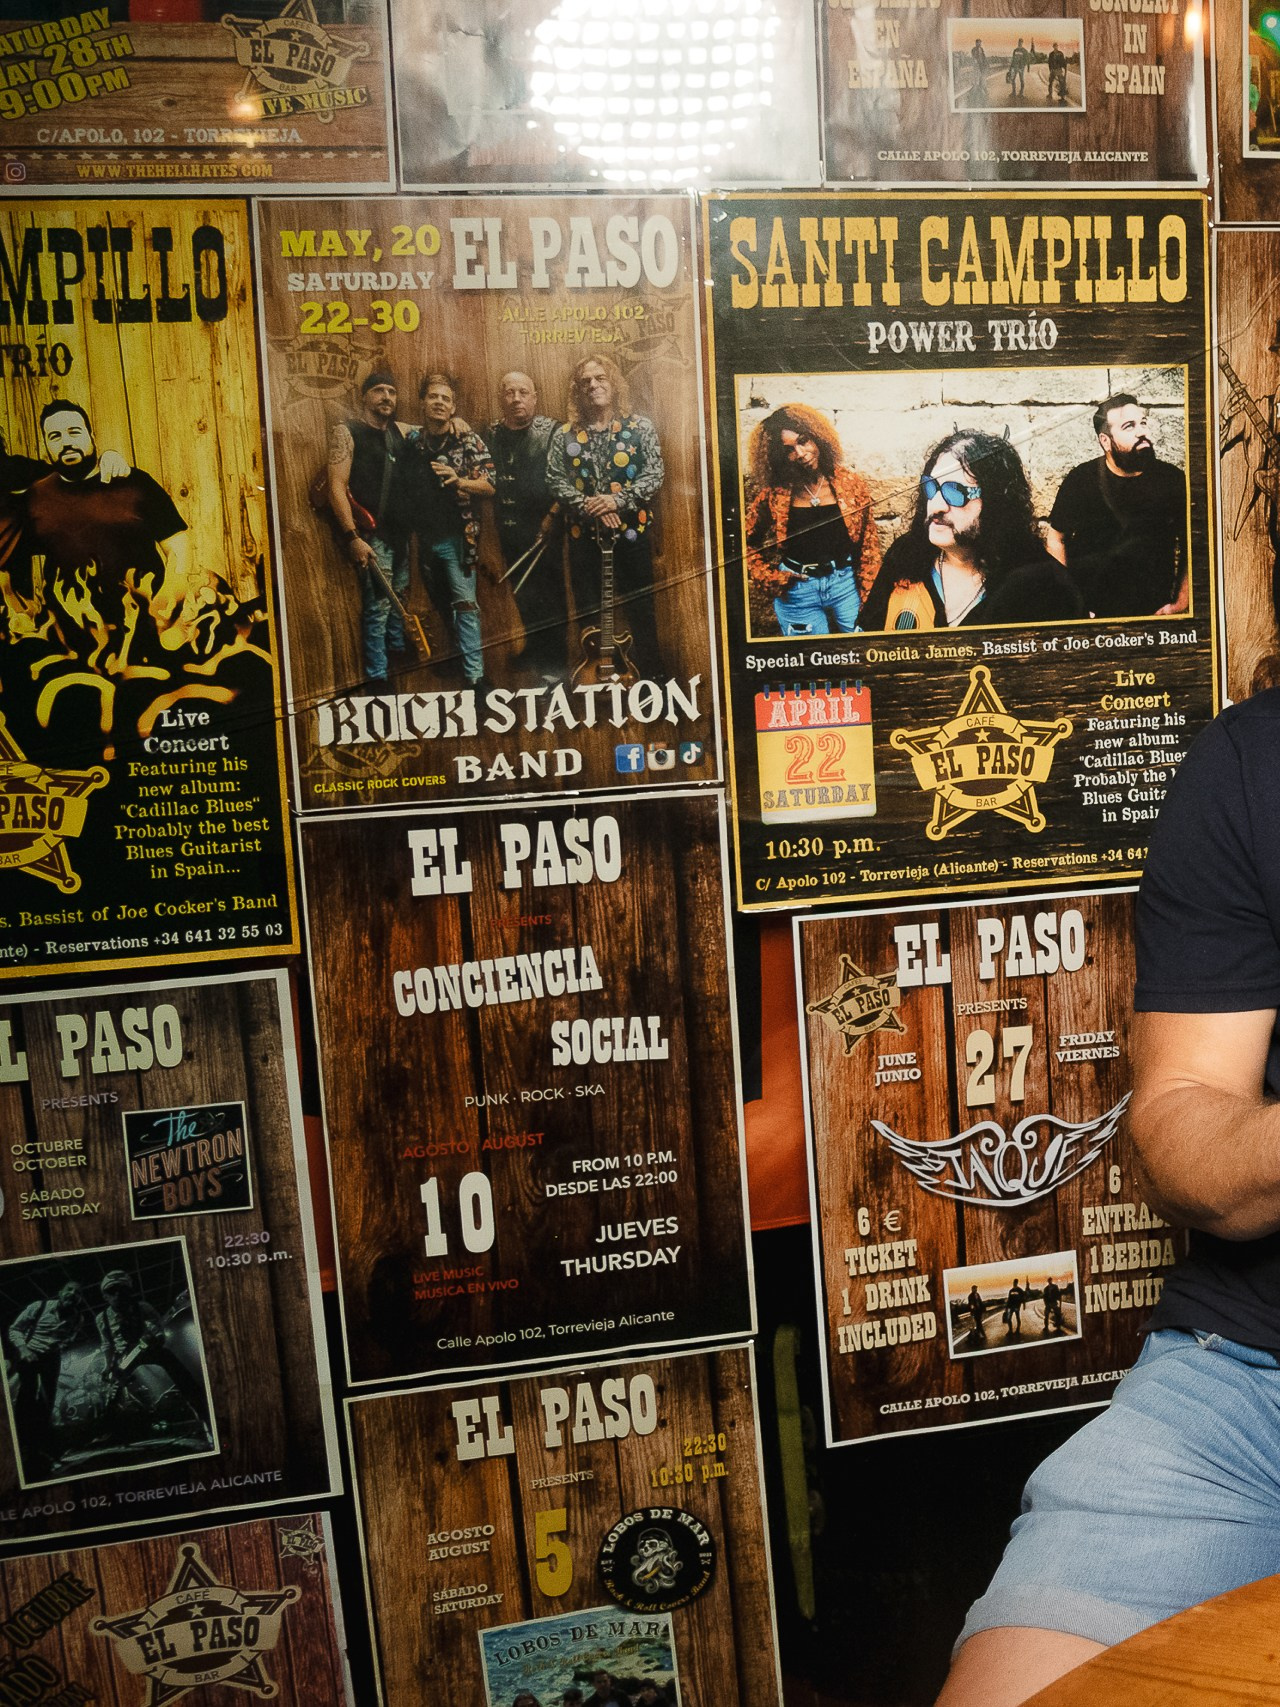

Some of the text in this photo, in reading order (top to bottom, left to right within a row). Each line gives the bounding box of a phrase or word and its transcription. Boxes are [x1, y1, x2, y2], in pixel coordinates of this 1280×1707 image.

[1123, 23, 1147, 53] IN
[43, 34, 134, 75] 28TH
[250, 39, 337, 77] EL PASO
[848, 55, 928, 89] ESPAÑA
[1105, 65, 1166, 95] SPAIN
[0, 68, 130, 119] 9:00PM
[296, 87, 368, 110] MUSIC
[37, 128, 128, 145] C/APOLO,
[134, 128, 165, 143] 102
[877, 151, 1149, 164] CALLE APOLO TORREVIEJA ALICANTE
[280, 224, 442, 263] MAY, 20
[450, 214, 679, 290] EL PASO
[729, 214, 1188, 309] SANTI CAMPILLO
[287, 271, 435, 291] SATURDAY
[300, 300, 421, 335] 22-30
[867, 319, 977, 354] POWER
[746, 629, 1198, 672] Special Guest: Oneida Bassist of Joe Band
[1114, 670, 1156, 687] Live
[318, 673, 703, 747] ROCK STATION
[767, 696, 861, 728] APRIL
[1100, 691, 1171, 711] Concert
[160, 709, 211, 728] Live
[1087, 712, 1186, 732] Featuring his
[143, 734, 230, 754] Concert
[1094, 737, 1124, 750] new
[128, 757, 249, 777] Featuring his
[453, 748, 584, 784] BAND
[784, 731, 848, 785] 22
[930, 745, 1036, 782] EL PASO
[138, 784, 174, 797] new
[314, 775, 448, 795] CLASSIC ROCK COVERS
[1073, 769, 1138, 787] Probably
[1142, 770, 1167, 783] the
[763, 783, 872, 809] SATURDAY
[114, 817, 271, 840] Probably the best
[126, 838, 263, 860] Blues Guitarist
[408, 815, 622, 897] EL PASO
[765, 837, 825, 860] 10:30
[150, 865, 168, 879] in
[776, 851, 1098, 891] Apolo Torrevieja Reservations
[19, 907, 85, 928] Bassist
[92, 906, 109, 921] of
[116, 904, 149, 920] Joe
[231, 894, 278, 911] Band
[45, 937, 149, 956] Reservations
[185, 928, 212, 944] 641
[218, 927, 237, 941] 32
[242, 925, 261, 939] 55
[265, 922, 284, 937] 03
[893, 909, 1086, 988] EL PASO
[393, 945, 604, 1017] CONCIENCIA
[855, 988, 891, 1014] PASO
[957, 998, 1028, 1016] PRESENTS
[56, 1003, 184, 1078] PASO
[551, 1016, 669, 1066] SOCIAL
[1059, 1031, 1116, 1047] FRIDAY
[877, 1052, 917, 1070] JUNE
[965, 1025, 1034, 1107] 27
[1055, 1046, 1121, 1063] VIERNES
[874, 1068, 922, 1087] JUNIO
[520, 1088, 565, 1103] ROCK
[153, 1110, 200, 1146] The
[11, 1139, 83, 1156] OCTUBRE
[131, 1128, 243, 1189] NEWTRON
[402, 1133, 545, 1159] AGOSTO AUGUST
[12, 1155, 87, 1172] OCTOBER
[572, 1153, 643, 1173] FROM 10
[162, 1167, 222, 1213] BOYS
[545, 1170, 678, 1198] DESDE LAS 22:00
[22, 1202, 101, 1220] SATURDAY
[419, 1171, 495, 1257] 10
[224, 1231, 270, 1249] 22:30
[595, 1216, 680, 1243] JUEVES
[560, 1246, 682, 1277] THURSDAY
[844, 1239, 918, 1278] TICKET
[1101, 1239, 1176, 1273] BEBIDA
[413, 1266, 485, 1284] LIVE MUSIC
[488, 1278, 519, 1292] VIVO
[865, 1275, 932, 1313] DRINK
[437, 1309, 675, 1350] Calle Apolo Torrevieja Alicante
[838, 1312, 938, 1354] INCLUDED
[880, 1377, 1079, 1415] CALLE APOLO TORREVIEJA
[451, 1373, 658, 1460] EL PASO
[684, 1433, 727, 1457] 22:30
[115, 1482, 207, 1504] TORREVIEJA
[531, 1470, 594, 1490] PRESENTS
[650, 1509, 673, 1519] DE
[426, 1525, 495, 1545] AGOSTO
[428, 1540, 491, 1561] AUGUST
[535, 1508, 573, 1597] 5
[434, 1593, 504, 1615] SATURDAY
[135, 1615, 260, 1665] EL PASO
[494, 1631, 561, 1667] LOBOS
[570, 1622, 599, 1641] DE
